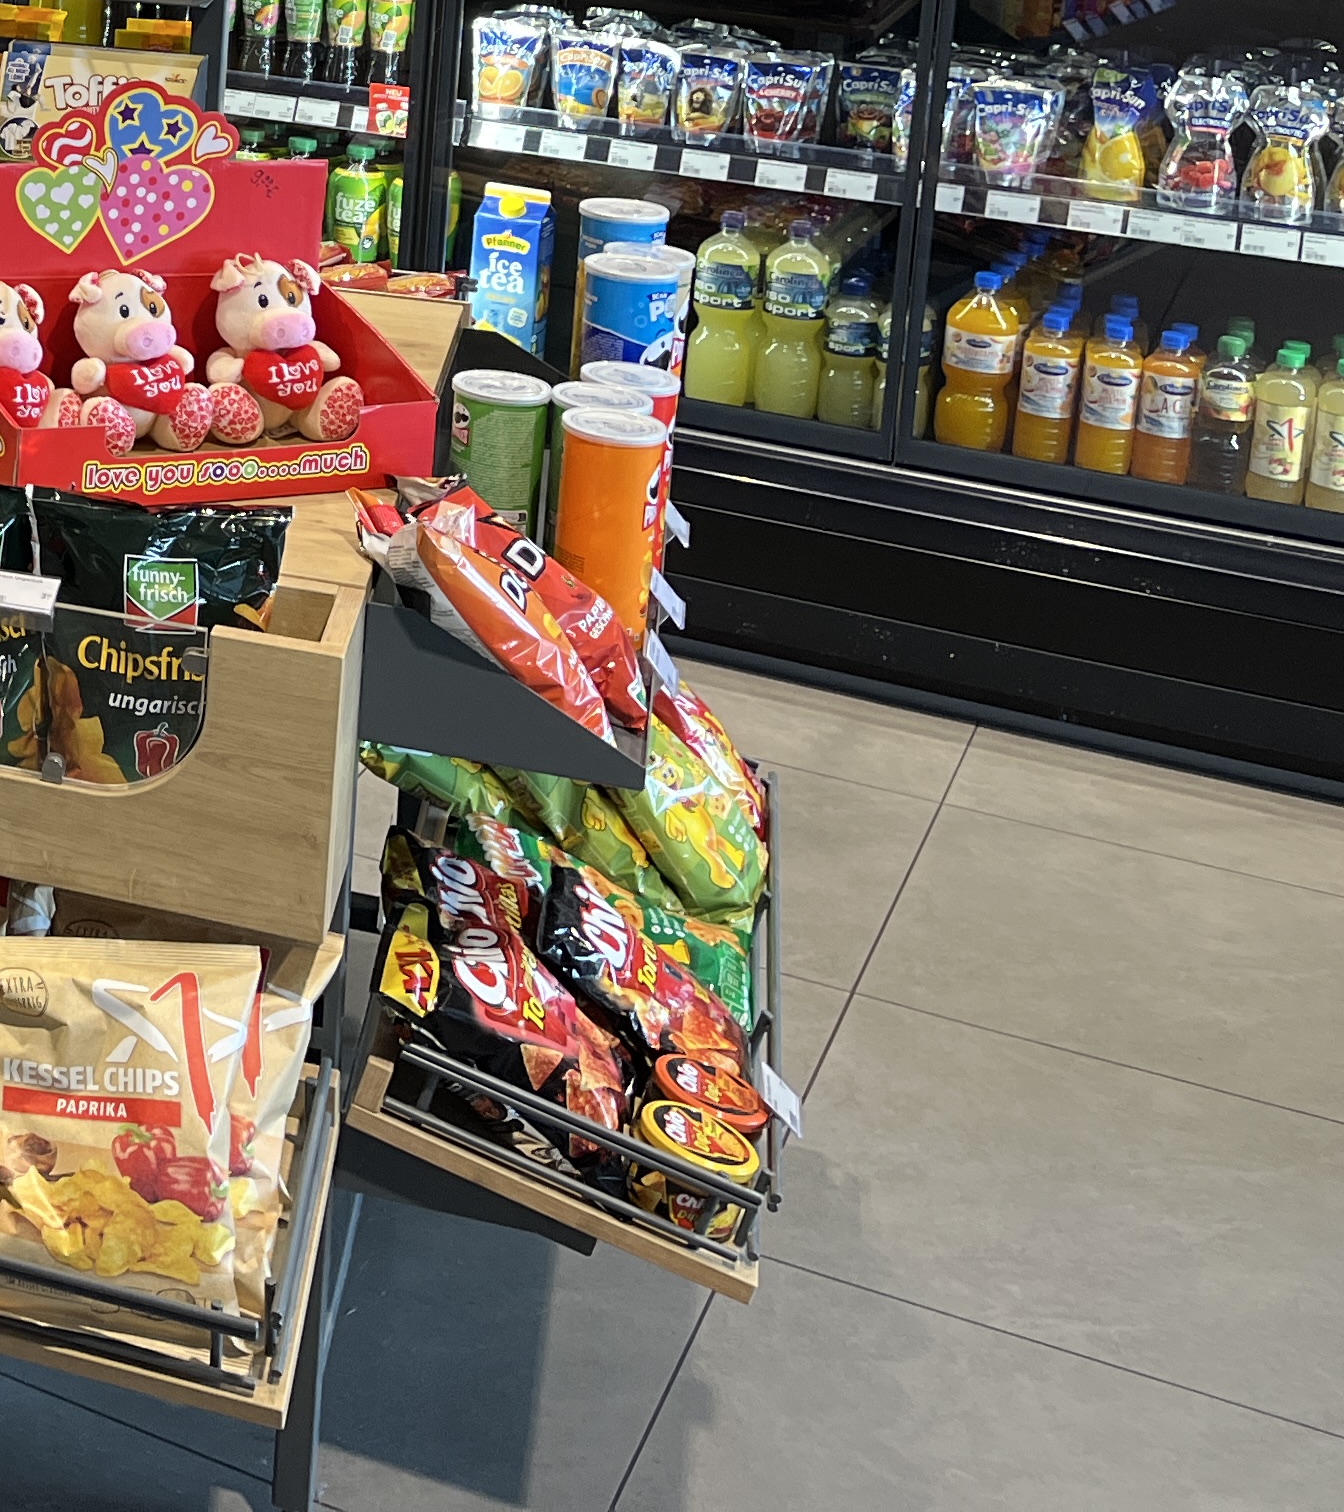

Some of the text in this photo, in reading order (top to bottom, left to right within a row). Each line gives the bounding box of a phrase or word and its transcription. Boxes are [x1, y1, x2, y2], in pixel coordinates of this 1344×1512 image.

[335, 192, 376, 215] fuze
[335, 208, 368, 224] tea
[488, 252, 523, 277] ice
[479, 269, 524, 296] tea
[766, 303, 817, 320] sport
[144, 375, 183, 397] you
[277, 376, 318, 397] you
[87, 466, 138, 491] love
[146, 462, 195, 492] you
[132, 565, 187, 589] funny-
[138, 582, 189, 604] frisch
[77, 636, 205, 683] Chipsfri
[2, 1058, 179, 1096] KESSEL CHIPS
[55, 1096, 128, 1119] PAPRIKA
